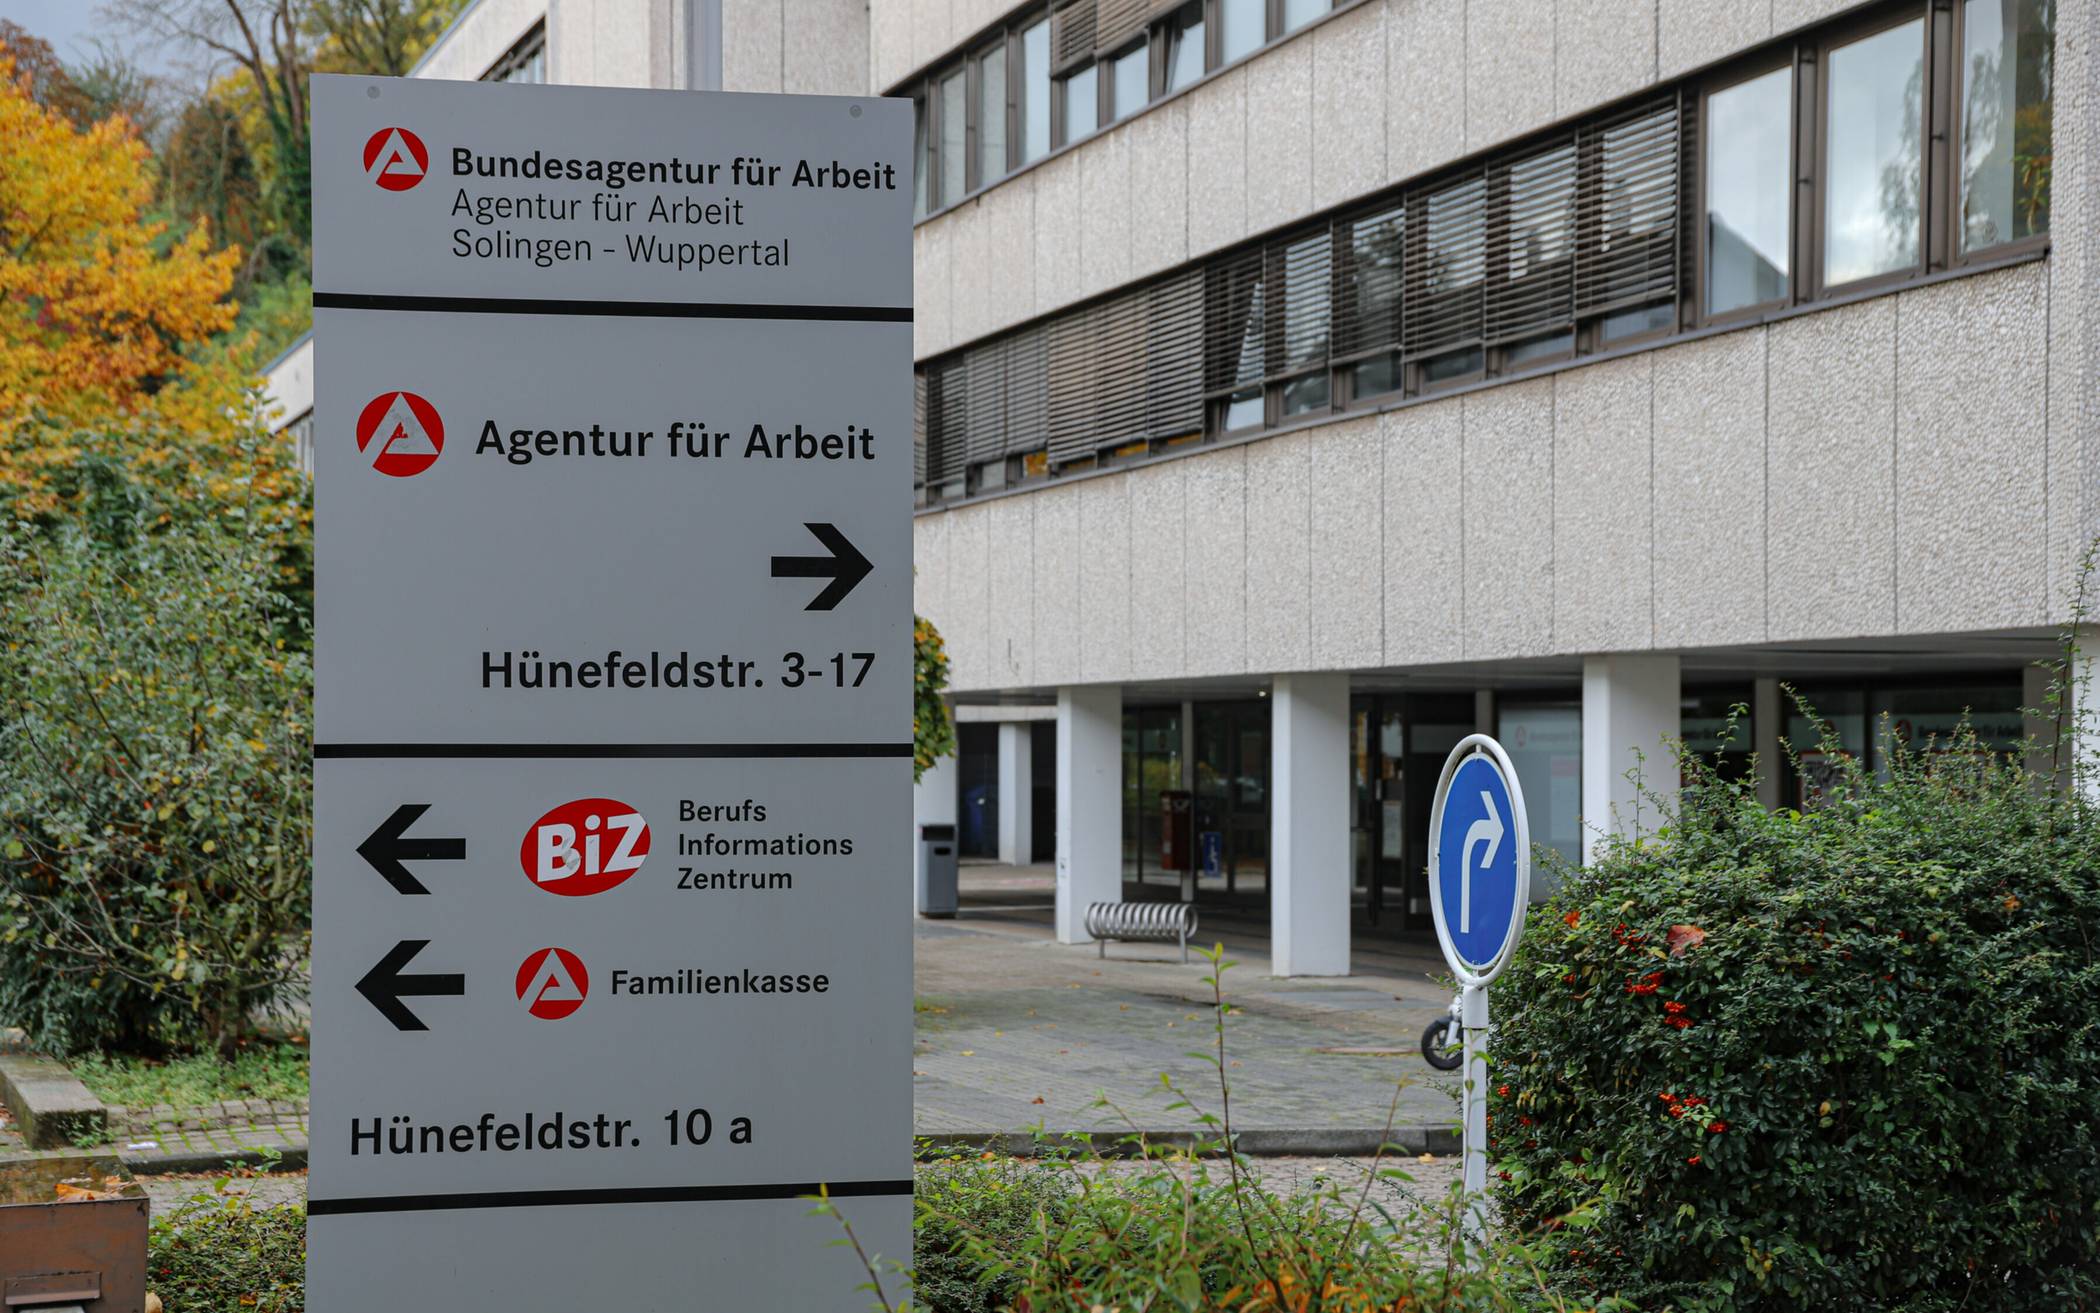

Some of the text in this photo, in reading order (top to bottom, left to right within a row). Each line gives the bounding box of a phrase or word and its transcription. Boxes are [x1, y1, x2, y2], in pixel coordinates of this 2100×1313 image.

[452, 147, 897, 191] Bundesagentur für Arbeit
[451, 188, 745, 226] Agentur für Arbeit
[451, 228, 593, 268] Solingen
[625, 234, 791, 273] Wuppertal
[475, 419, 876, 467] Agentur für Arbeit
[481, 650, 877, 690] Hünefeldstr. 3-17
[678, 799, 768, 823] Berufs
[536, 812, 648, 883] BiZ
[677, 832, 854, 857] Informations
[676, 867, 793, 890] Zentrum
[610, 968, 830, 996] Familienkasse
[350, 1107, 754, 1157] Hünefeldstr. 10 a
